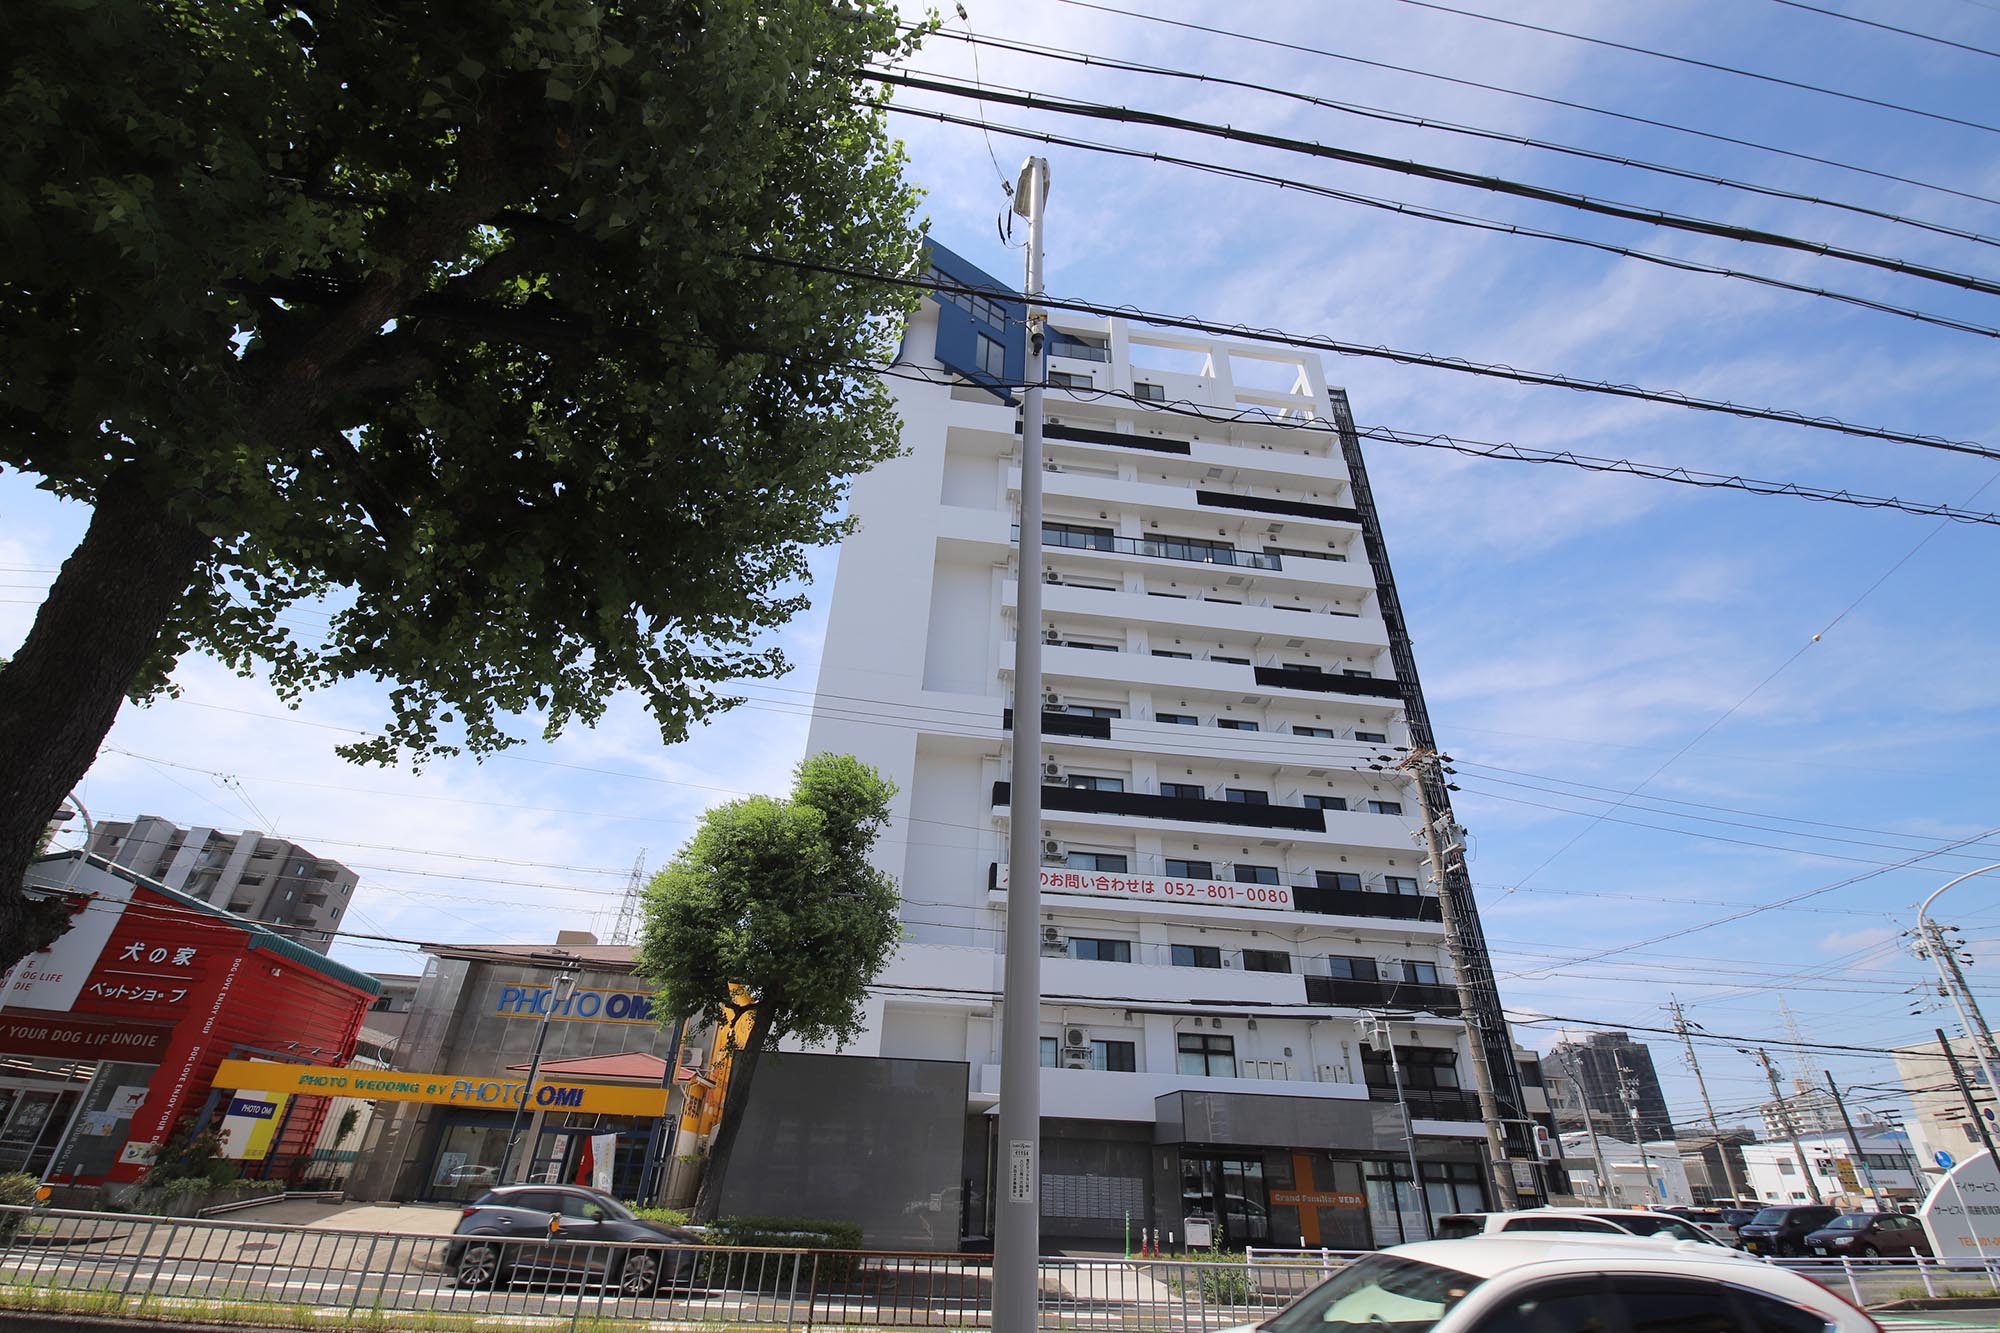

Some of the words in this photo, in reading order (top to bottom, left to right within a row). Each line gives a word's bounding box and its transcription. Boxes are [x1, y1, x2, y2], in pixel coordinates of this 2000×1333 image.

[1164, 881, 1288, 903] 052-801-0080
[119, 941, 197, 966] 犬の家
[39, 973, 63, 982] LIFE
[89, 982, 188, 1003] ペットショップ
[497, 986, 601, 1018] PHOTO
[605, 993, 656, 1020] OM
[9, 1026, 48, 1040] YOUR
[51, 1030, 82, 1043] DOG
[187, 1046, 201, 1062] DOG
[178, 1063, 193, 1082] LOVE
[298, 1074, 348, 1088] PHOTO
[354, 1079, 420, 1093] WEDDING
[449, 1079, 532, 1104] PHOTO
[536, 1085, 585, 1107] OMI
[241, 1104, 260, 1113] PHOTO
